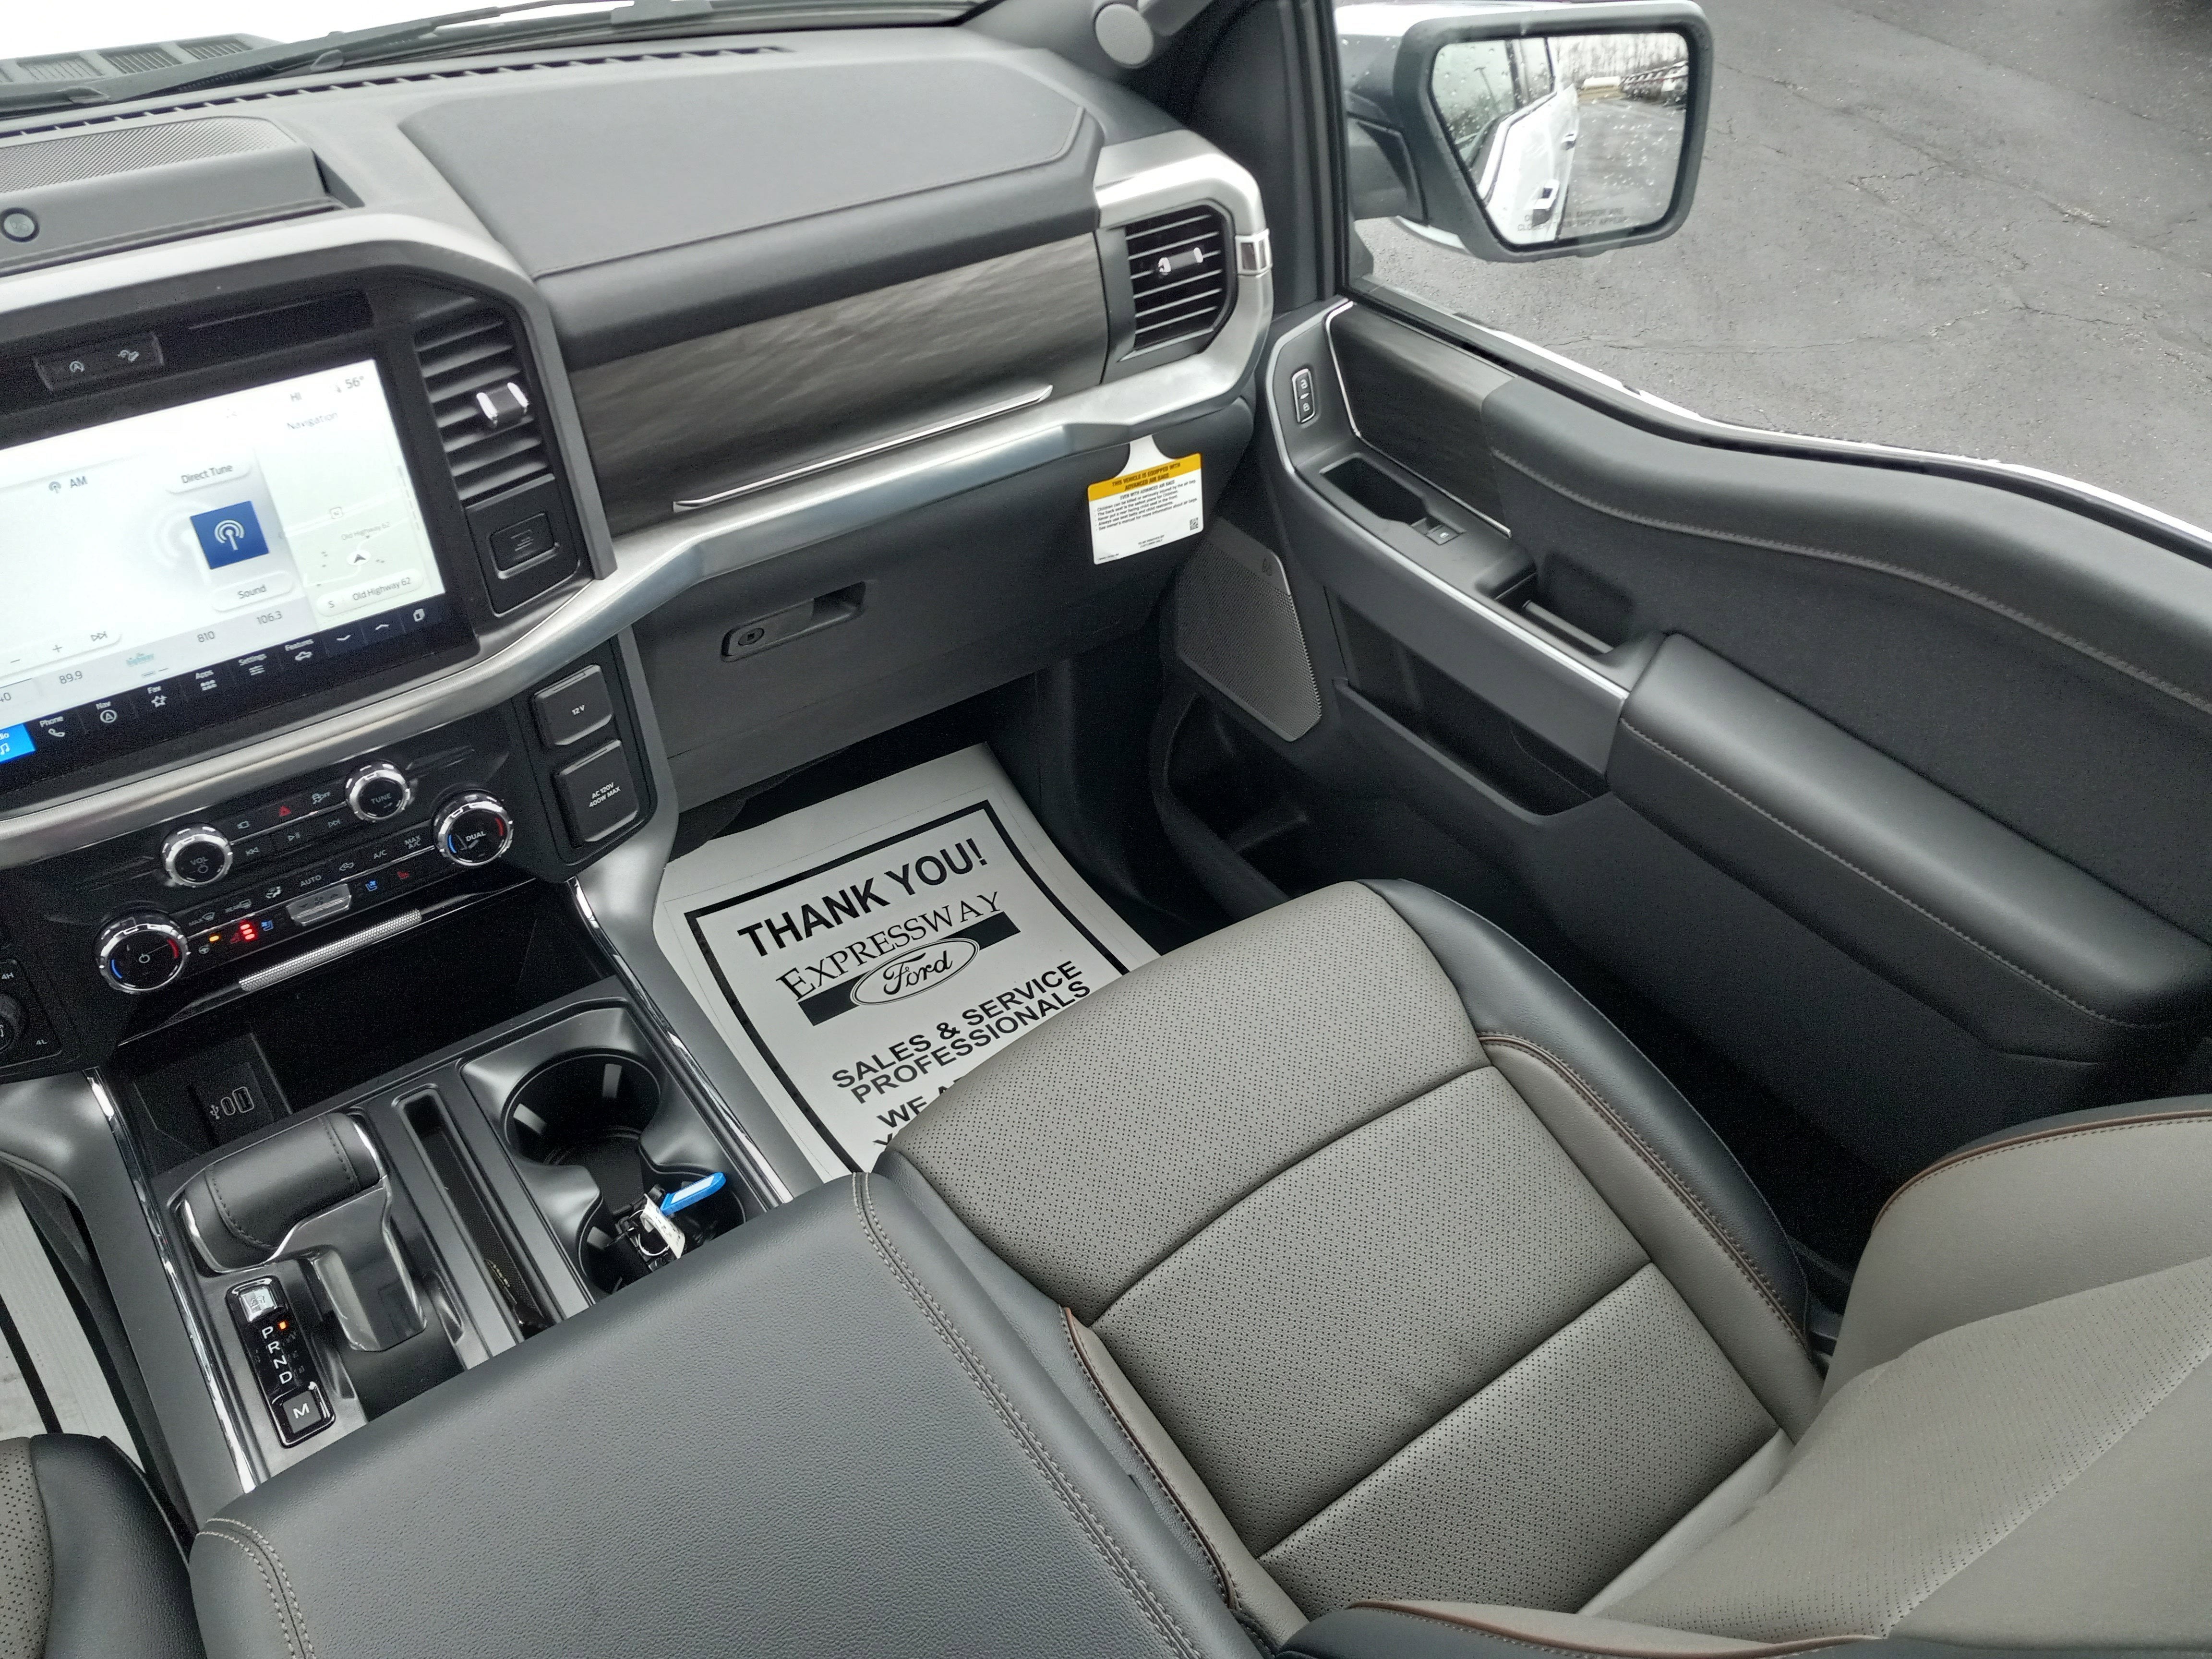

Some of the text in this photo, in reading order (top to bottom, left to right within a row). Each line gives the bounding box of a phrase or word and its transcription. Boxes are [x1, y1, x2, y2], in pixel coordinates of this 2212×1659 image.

[287, 412, 338, 429] Navigation
[70, 475, 88, 489] AM
[181, 464, 234, 484] Direct Tune
[237, 584, 267, 599] Sound
[353, 591, 367, 601] Old
[368, 582, 400, 598] Highway
[401, 577, 411, 586] 62
[59, 670, 83, 685] 89.9
[197, 630, 215, 643] 810
[256, 610, 282, 625] 106.3
[39, 715, 64, 728] Phone
[96, 701, 111, 710] Nav
[147, 685, 162, 695] Fav
[195, 670, 214, 680] Apps
[239, 653, 267, 666] Settings
[285, 638, 314, 651] Features
[370, 793, 392, 805] TUNE
[589, 786, 621, 808] 400W MAX
[591, 782, 614, 800] AC 120V
[404, 835, 422, 845] MAX
[465, 831, 487, 842] DUAL
[408, 840, 422, 850] A/C
[190, 856, 209, 866] VOL
[373, 849, 388, 859] A/C
[300, 874, 322, 887] AUTO
[737, 837, 988, 957] THANK YOU!
[776, 891, 1004, 1001] EXPRESSWAY
[1, 972, 14, 980] 4H
[882, 951, 953, 996] Ford
[831, 960, 1083, 1088] SALES & SERVICE
[850, 980, 1091, 1104] PROFESSIONALS
[876, 1095, 927, 1128] WE
[261, 1325, 274, 1339] P
[267, 1340, 281, 1354] R
[273, 1355, 288, 1370] N
[279, 1371, 293, 1385] D
[292, 1402, 310, 1419] M
